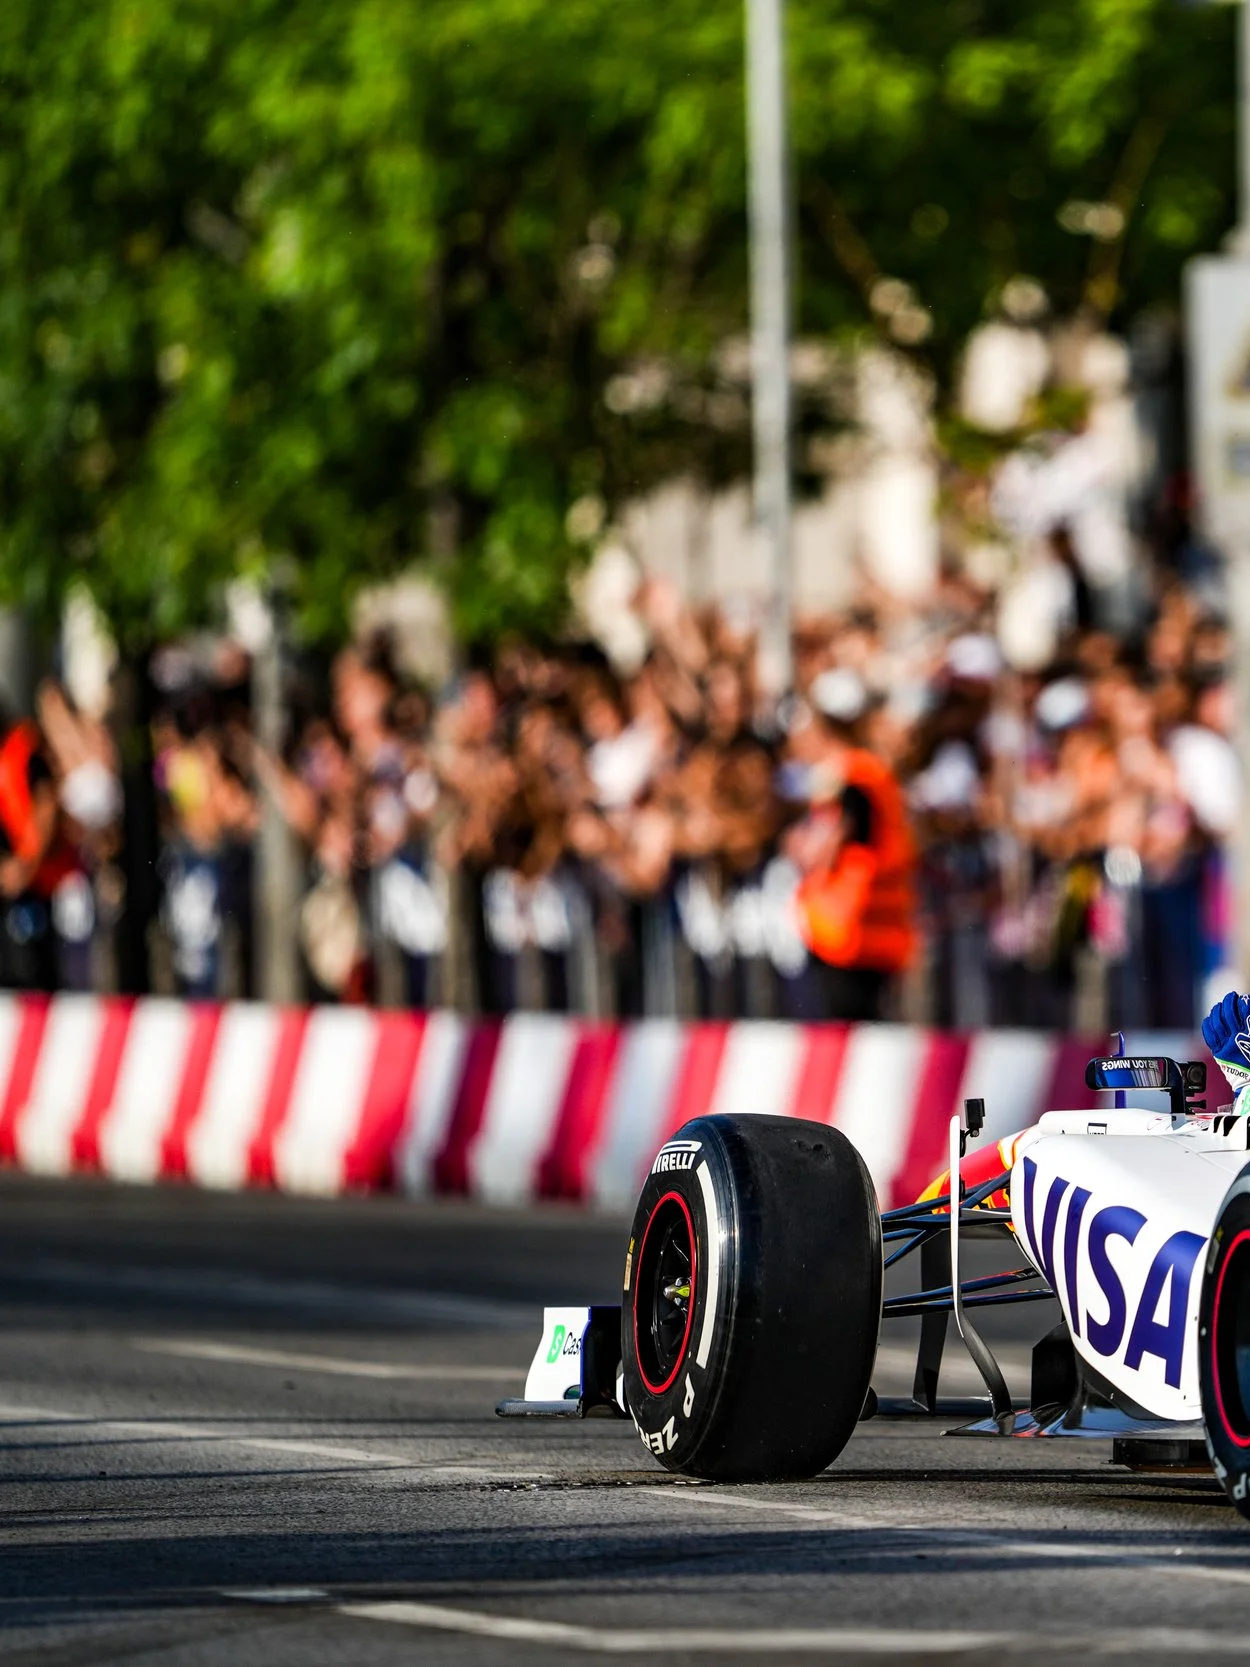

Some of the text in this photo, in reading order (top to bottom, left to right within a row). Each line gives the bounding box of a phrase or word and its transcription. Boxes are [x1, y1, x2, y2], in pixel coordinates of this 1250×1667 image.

[1226, 1066, 1249, 1079] TUDOR
[651, 1140, 702, 1175] PIRELLI
[1023, 1156, 1208, 1390] VISA
